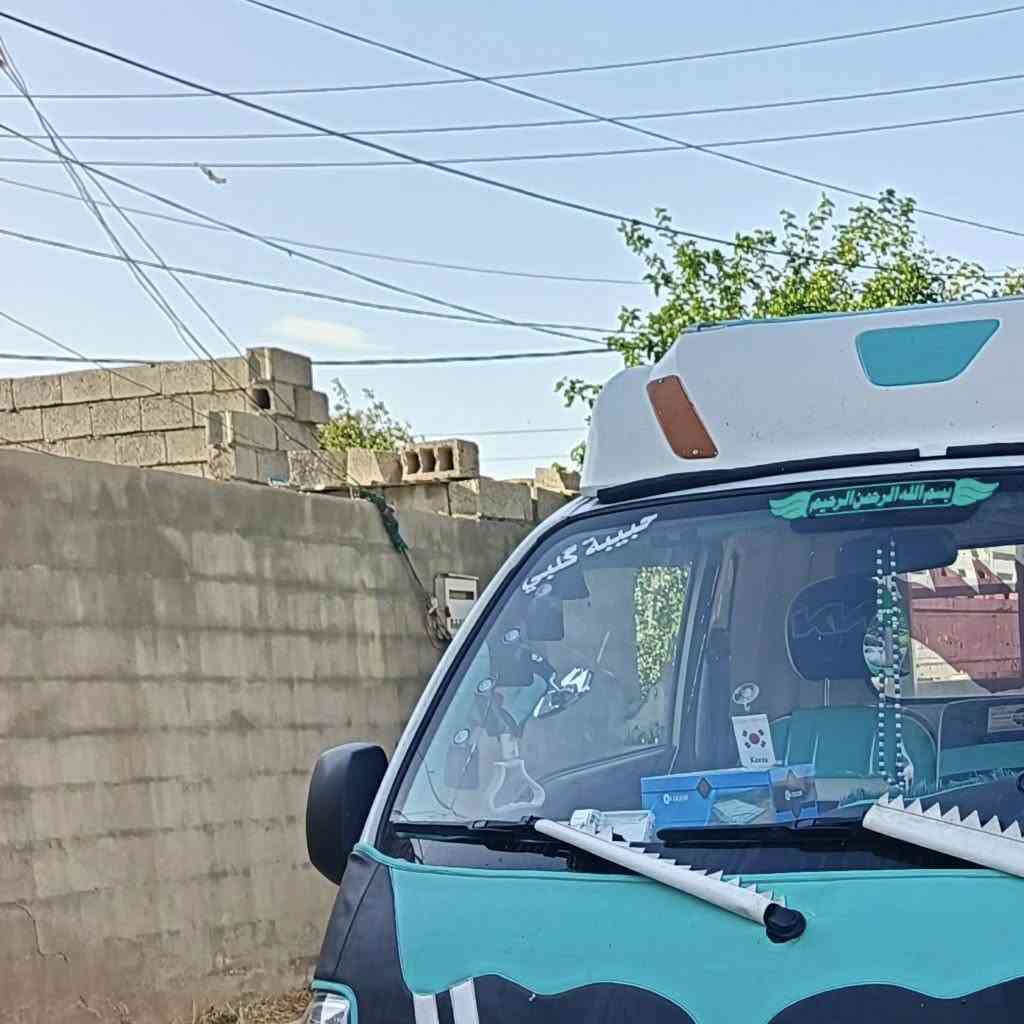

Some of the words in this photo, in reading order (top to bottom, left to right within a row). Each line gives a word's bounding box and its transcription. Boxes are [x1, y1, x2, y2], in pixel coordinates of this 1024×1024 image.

[809, 489, 856, 514] الرحيم
[853, 485, 900, 511] الرحمن
[899, 484, 925, 502] الله
[922, 486, 953, 505] بسم
